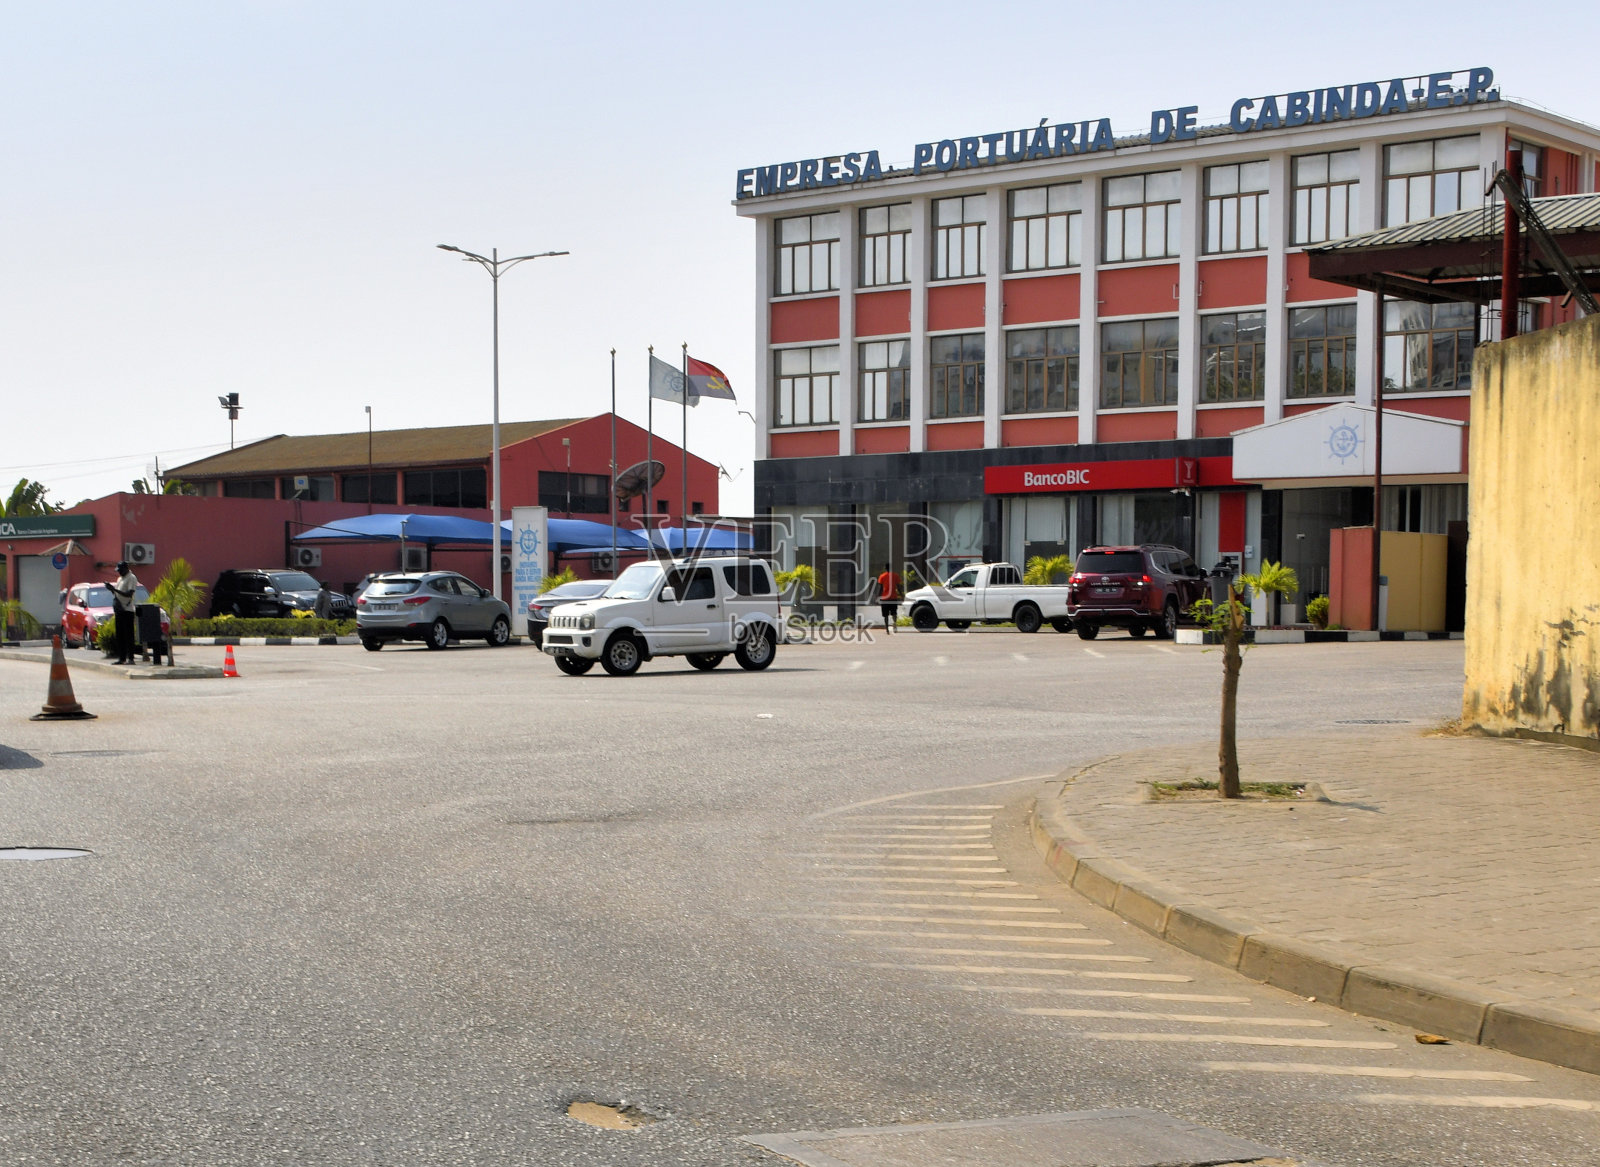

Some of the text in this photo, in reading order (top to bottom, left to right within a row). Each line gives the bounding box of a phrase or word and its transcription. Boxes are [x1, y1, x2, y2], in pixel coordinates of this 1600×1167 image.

[736, 150, 883, 199] EMPRESA
[913, 117, 1116, 175] PORTUÁRIA
[1150, 106, 1199, 145] DE
[1024, 469, 1090, 487] BancoBIC
[0, 522, 16, 536] CA
